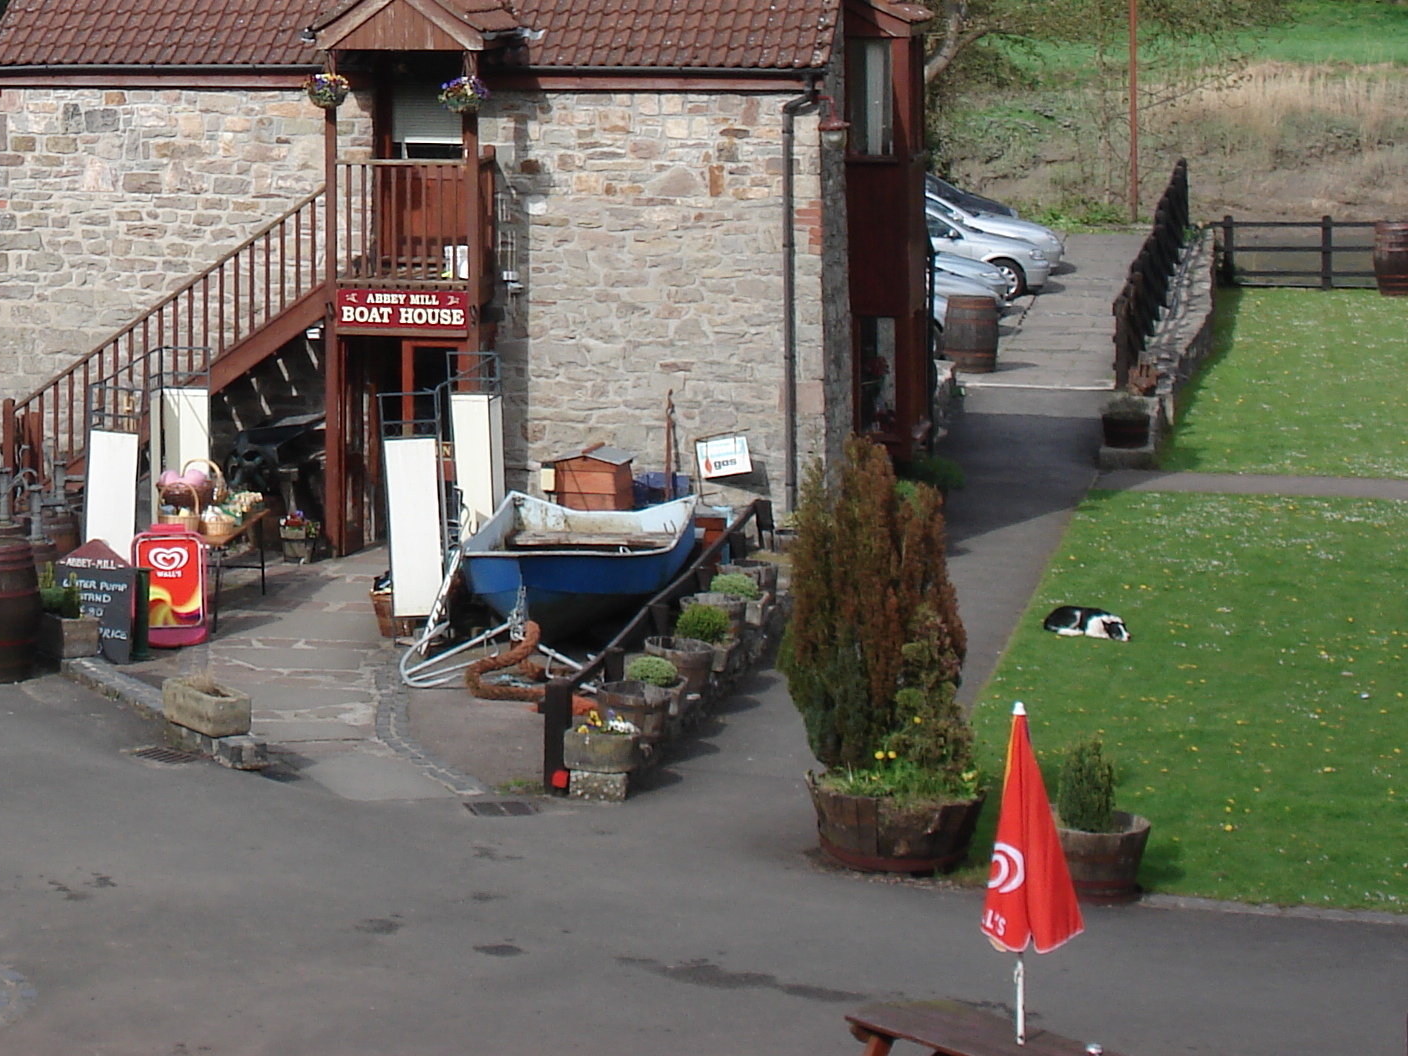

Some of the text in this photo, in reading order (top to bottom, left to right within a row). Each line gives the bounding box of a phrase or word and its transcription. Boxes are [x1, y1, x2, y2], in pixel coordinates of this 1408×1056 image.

[366, 293, 439, 305] ABBEY MILL
[341, 306, 465, 325] BOAT HOUSE
[713, 458, 737, 470] gas
[99, 581, 128, 592] PUMP
